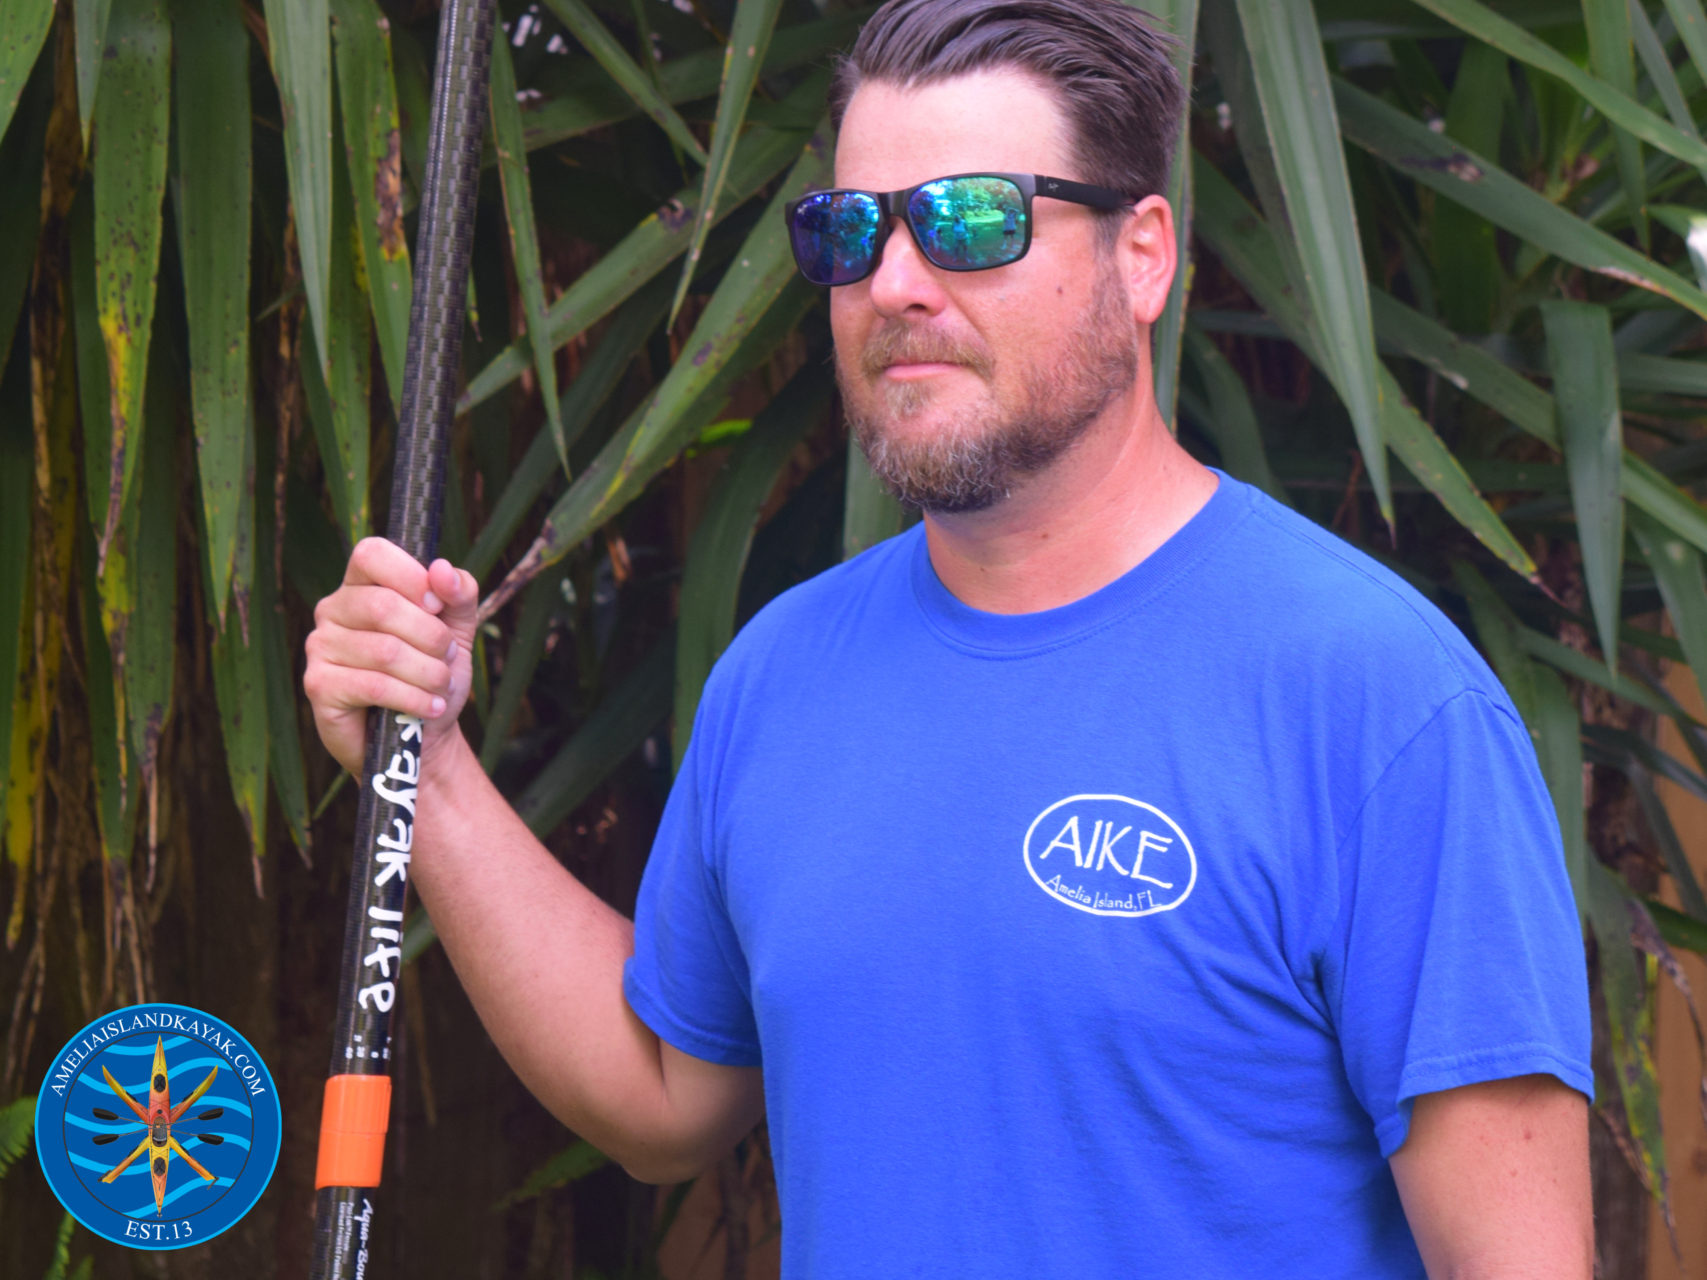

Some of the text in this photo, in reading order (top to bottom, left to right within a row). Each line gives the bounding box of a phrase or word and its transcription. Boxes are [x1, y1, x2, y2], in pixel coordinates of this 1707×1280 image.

[372, 713, 424, 887] kayak
[1039, 815, 1174, 890] AIKE
[1045, 874, 1092, 905] Amelia
